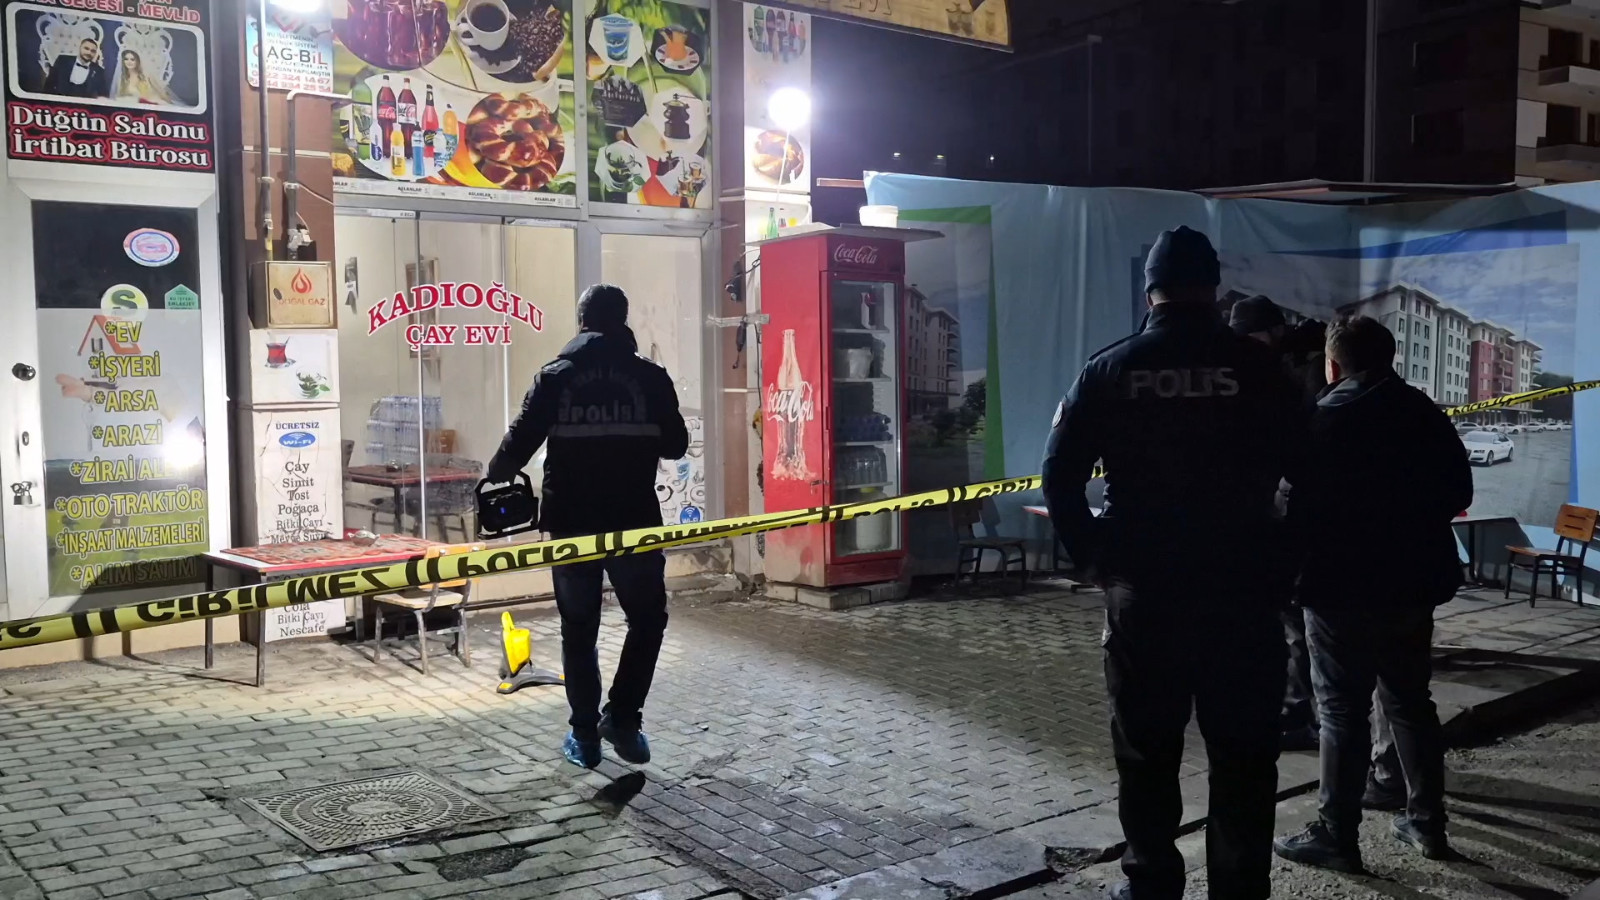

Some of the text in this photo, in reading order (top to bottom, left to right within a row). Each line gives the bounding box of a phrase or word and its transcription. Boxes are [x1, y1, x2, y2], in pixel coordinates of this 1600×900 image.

[138, 4, 200, 23] MEVLİD
[13, 105, 206, 141] Düğün Salonu
[14, 128, 209, 166] İrtibat Bürosu
[308, 297, 326, 306] GAZ
[368, 281, 544, 335] KADIOĞLU
[405, 321, 512, 349] ÇAY EVİ
[276, 420, 320, 430] ÜCRETSİZ
[285, 461, 310, 475] Çay
[282, 477, 314, 489] Simit
[112, 485, 204, 516] TRAKTÖR
[287, 490, 310, 501] Tost
[278, 503, 319, 517] Poğaça
[276, 518, 300, 531] Bitki
[115, 517, 205, 551] MALZEMELERİ
[136, 556, 197, 582] SATIM
[278, 613, 300, 625] Bitki
